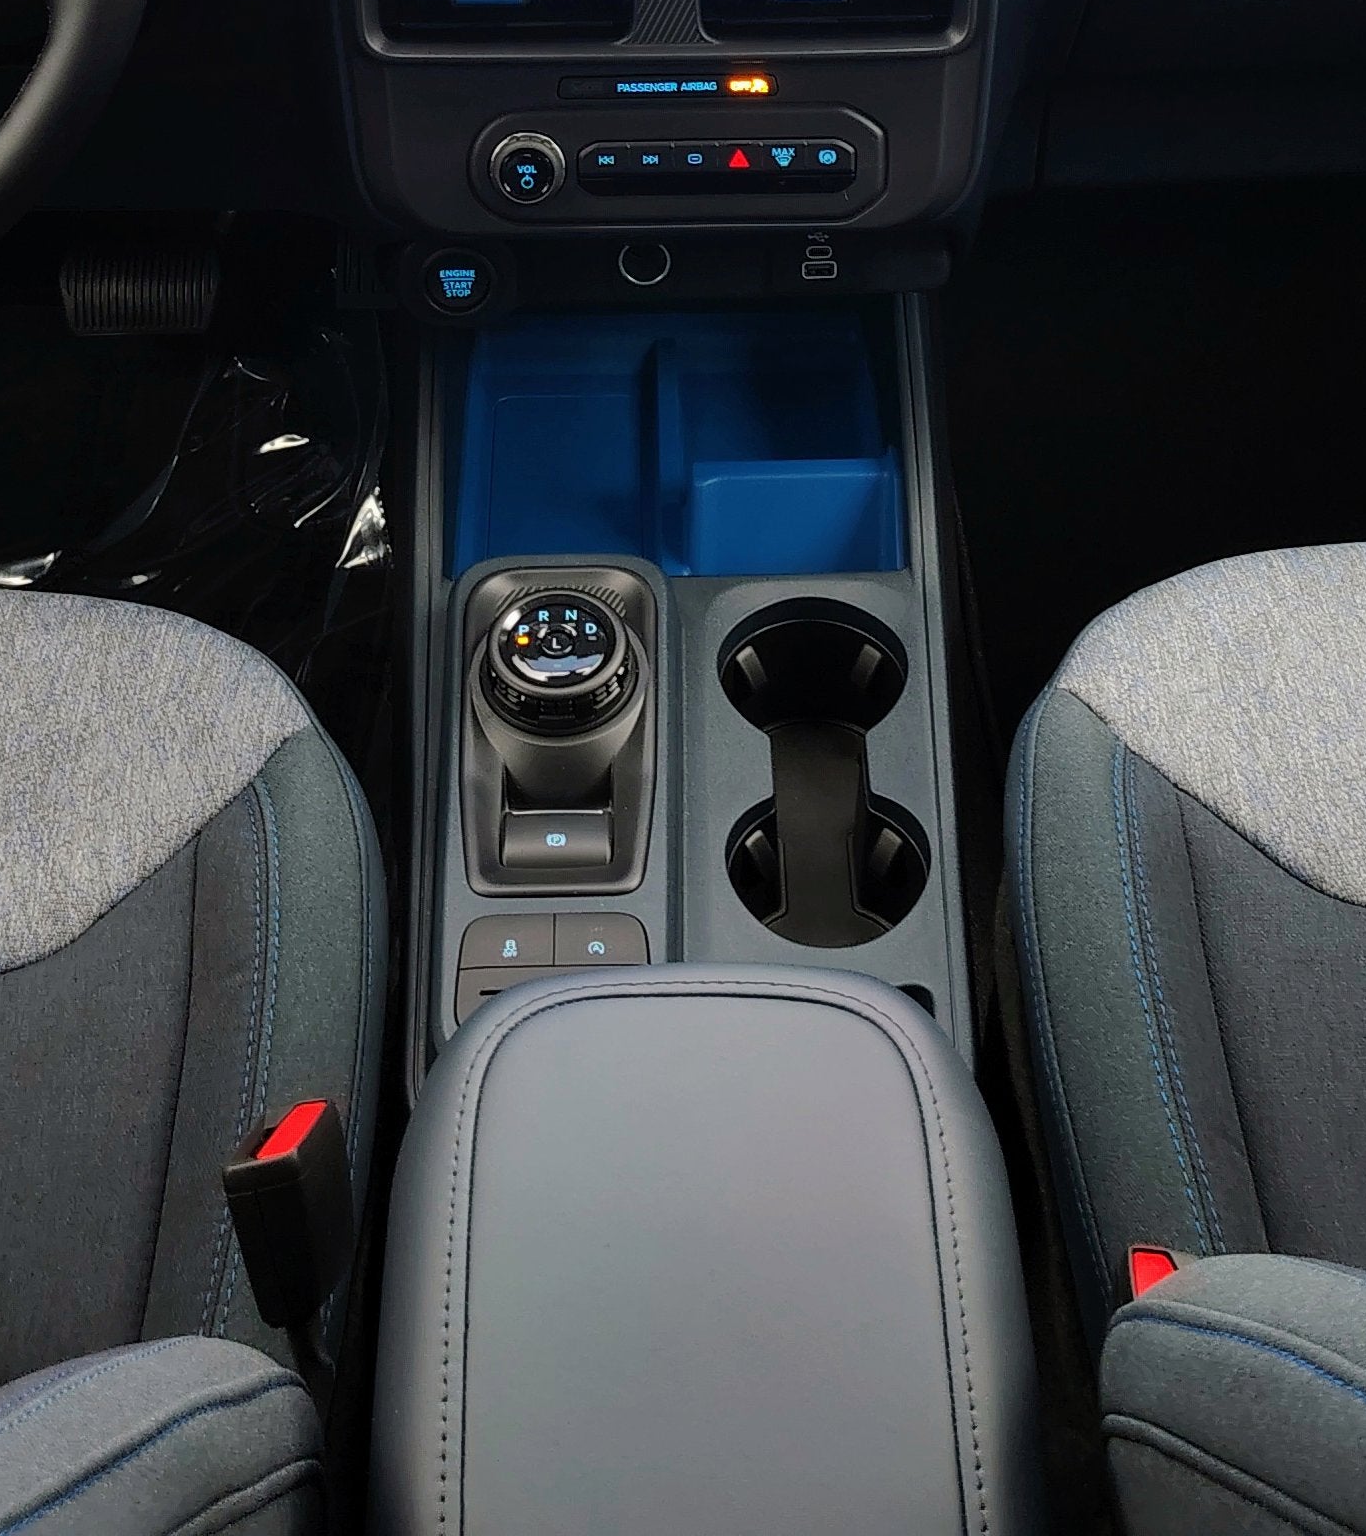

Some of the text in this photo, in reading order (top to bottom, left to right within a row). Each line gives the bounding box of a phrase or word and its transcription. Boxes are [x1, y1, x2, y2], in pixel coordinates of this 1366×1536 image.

[616, 81, 678, 93] PASSENGER
[679, 80, 718, 92] AIRBAG
[771, 147, 796, 157] MAX
[516, 164, 538, 174] VOL
[439, 269, 476, 278] ENGINE
[443, 281, 473, 290] START
[445, 289, 471, 298] STOP
[538, 610, 550, 622] R
[564, 609, 578, 621] N
[518, 624, 530, 636] P
[585, 622, 598, 635] D
[552, 637, 562, 649] L
